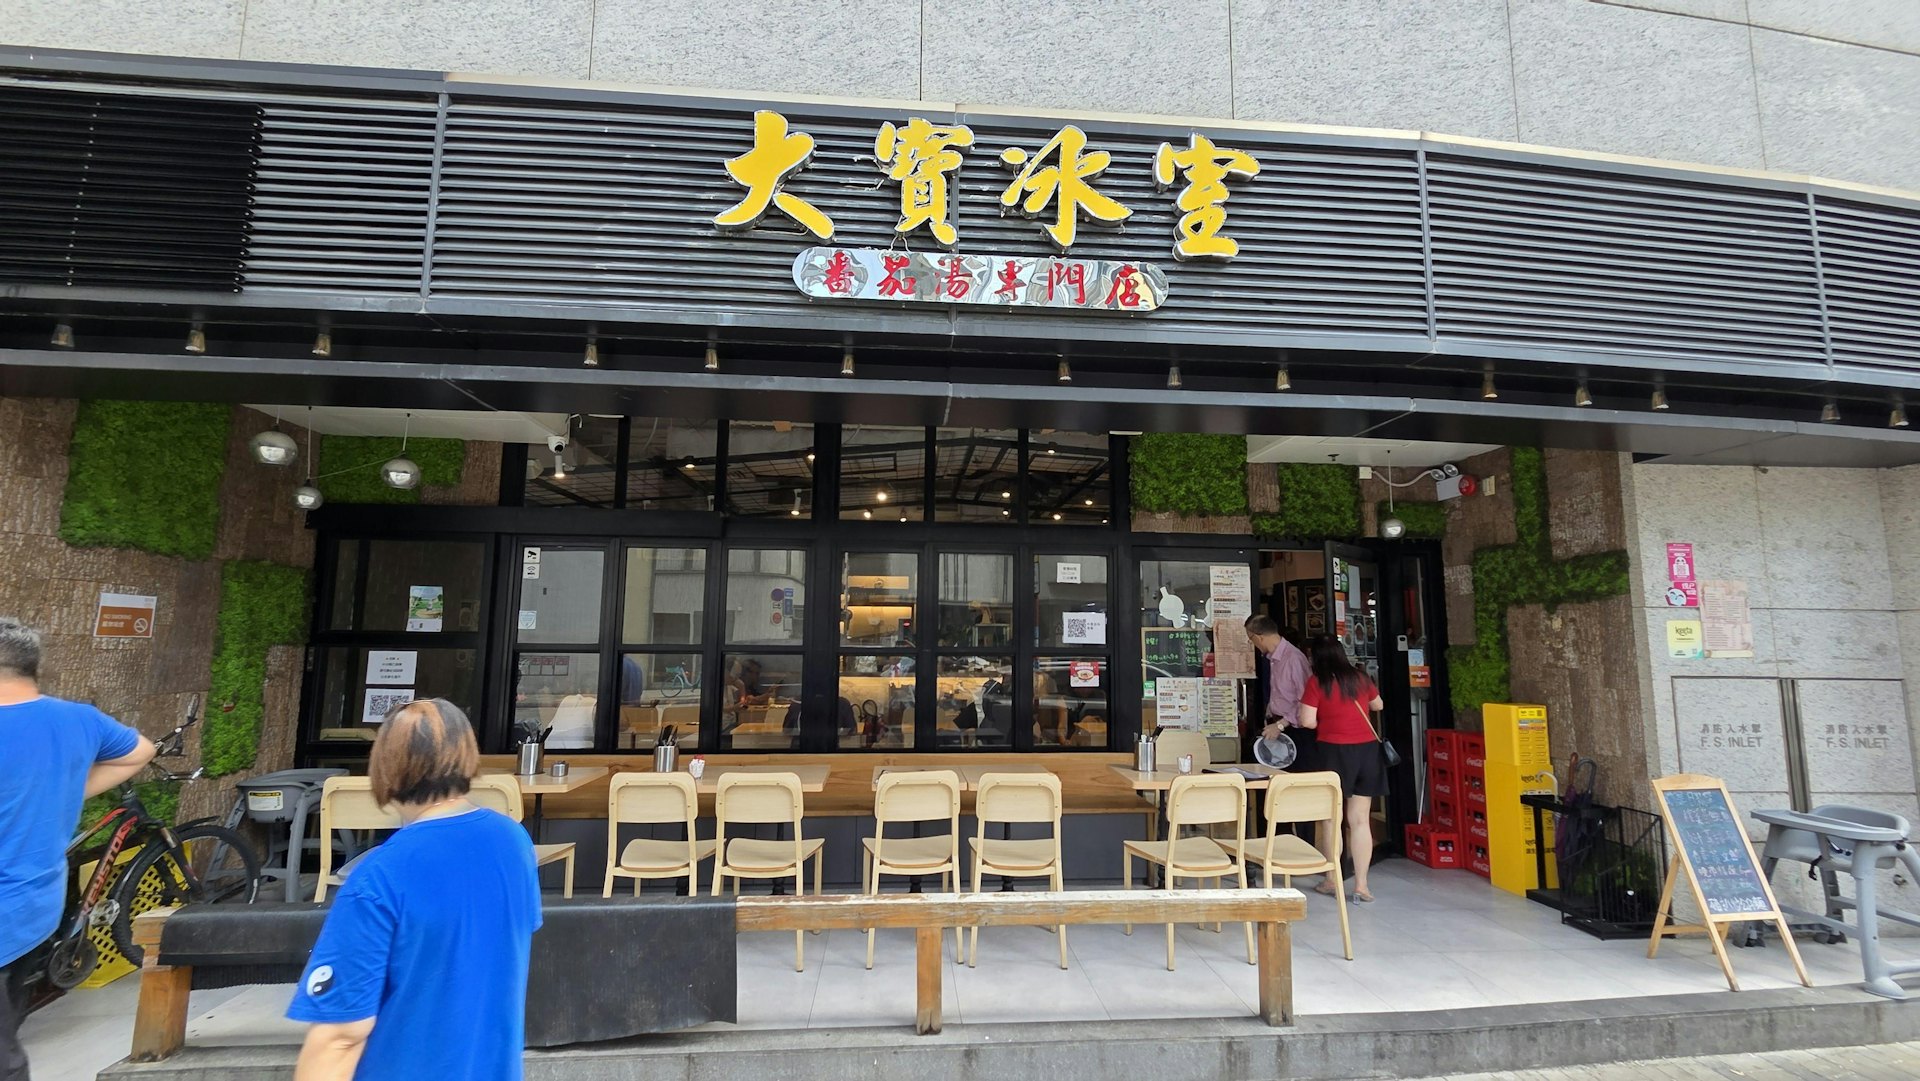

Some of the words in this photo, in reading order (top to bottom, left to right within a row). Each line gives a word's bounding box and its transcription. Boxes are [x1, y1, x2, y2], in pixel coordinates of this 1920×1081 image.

[713, 109, 1261, 262] 大寶冰室
[821, 251, 1143, 307] 番茄湯專門店
[1701, 736, 1711, 748] F.
[1728, 736, 1763, 748] INLET
[1854, 737, 1890, 749] INLET
